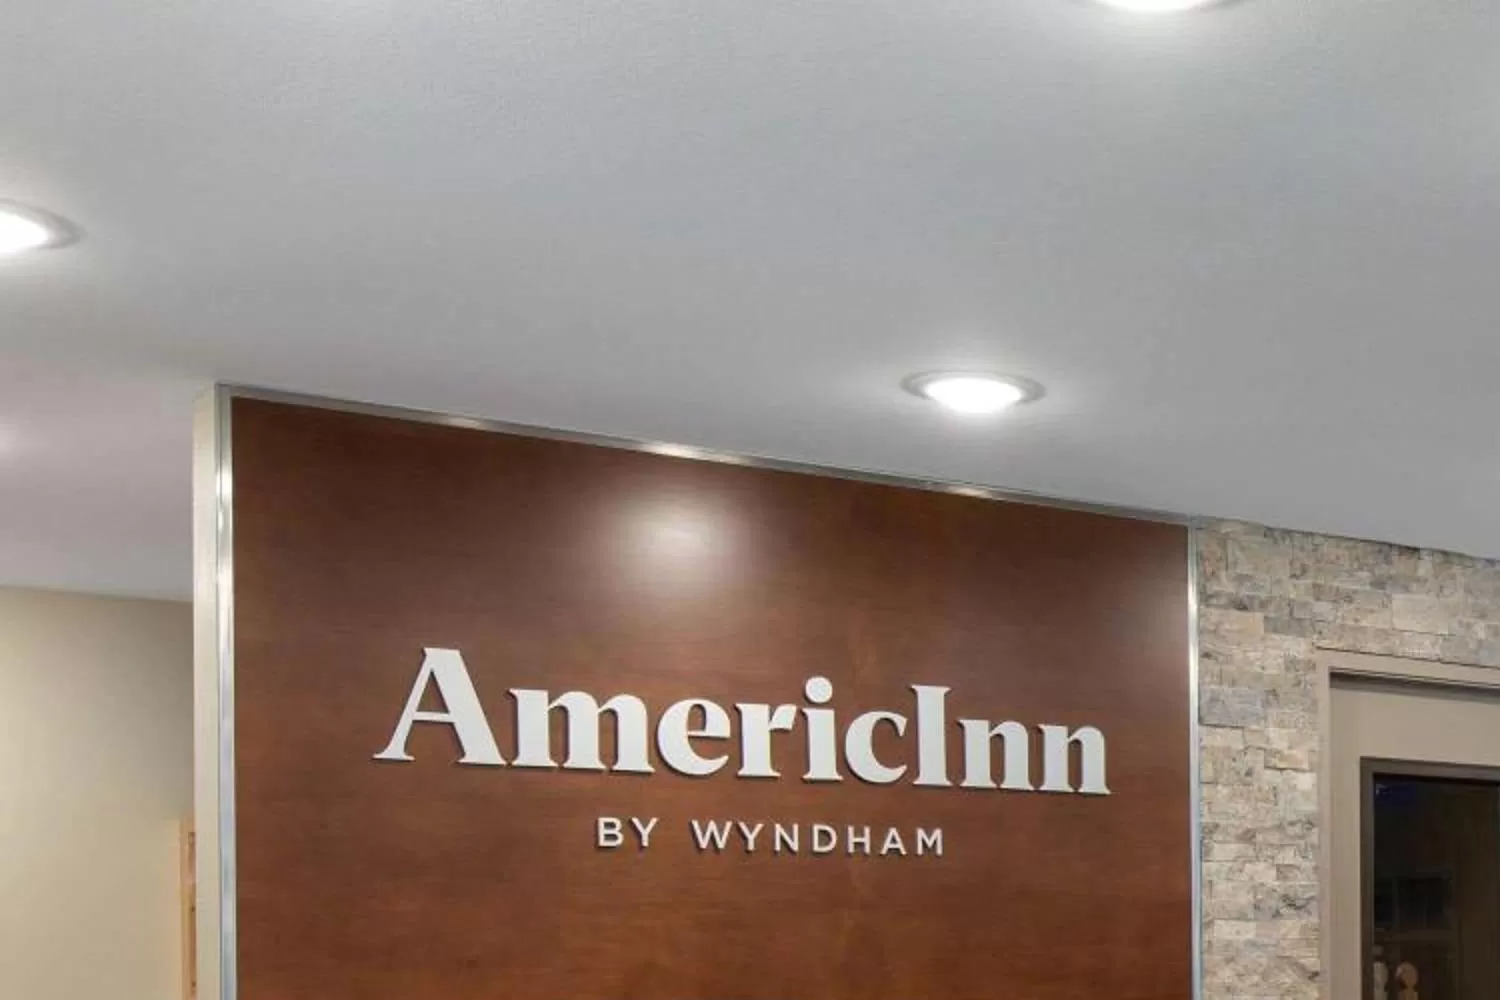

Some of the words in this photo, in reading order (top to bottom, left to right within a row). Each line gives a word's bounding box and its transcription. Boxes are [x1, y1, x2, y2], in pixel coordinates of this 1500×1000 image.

[372, 646, 1112, 797] AmericInn
[597, 816, 658, 848] BY
[691, 818, 944, 856] WYNDHAM
